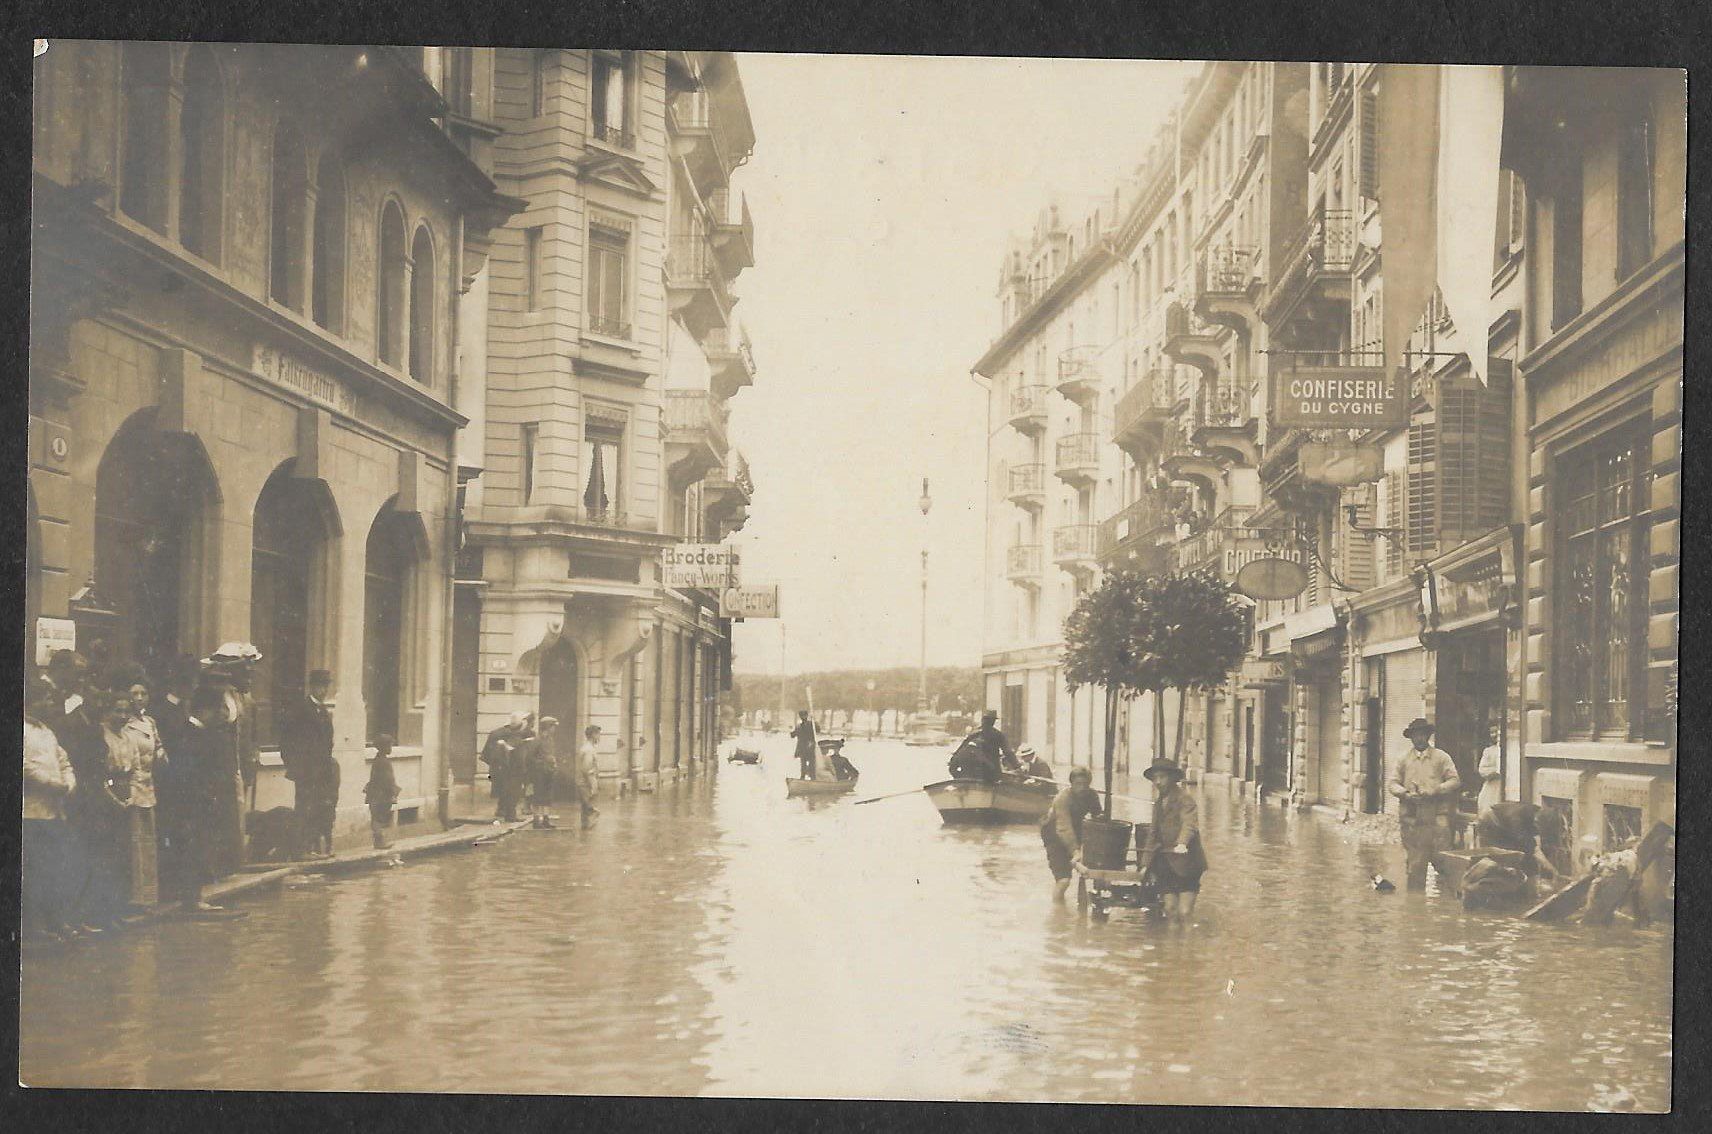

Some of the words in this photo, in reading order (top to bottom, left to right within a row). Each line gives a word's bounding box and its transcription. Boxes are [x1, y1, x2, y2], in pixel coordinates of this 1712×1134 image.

[1290, 379, 1395, 399] CONFISERIE
[1300, 401, 1322, 414] DU
[1328, 402, 1384, 415] CYGNE
